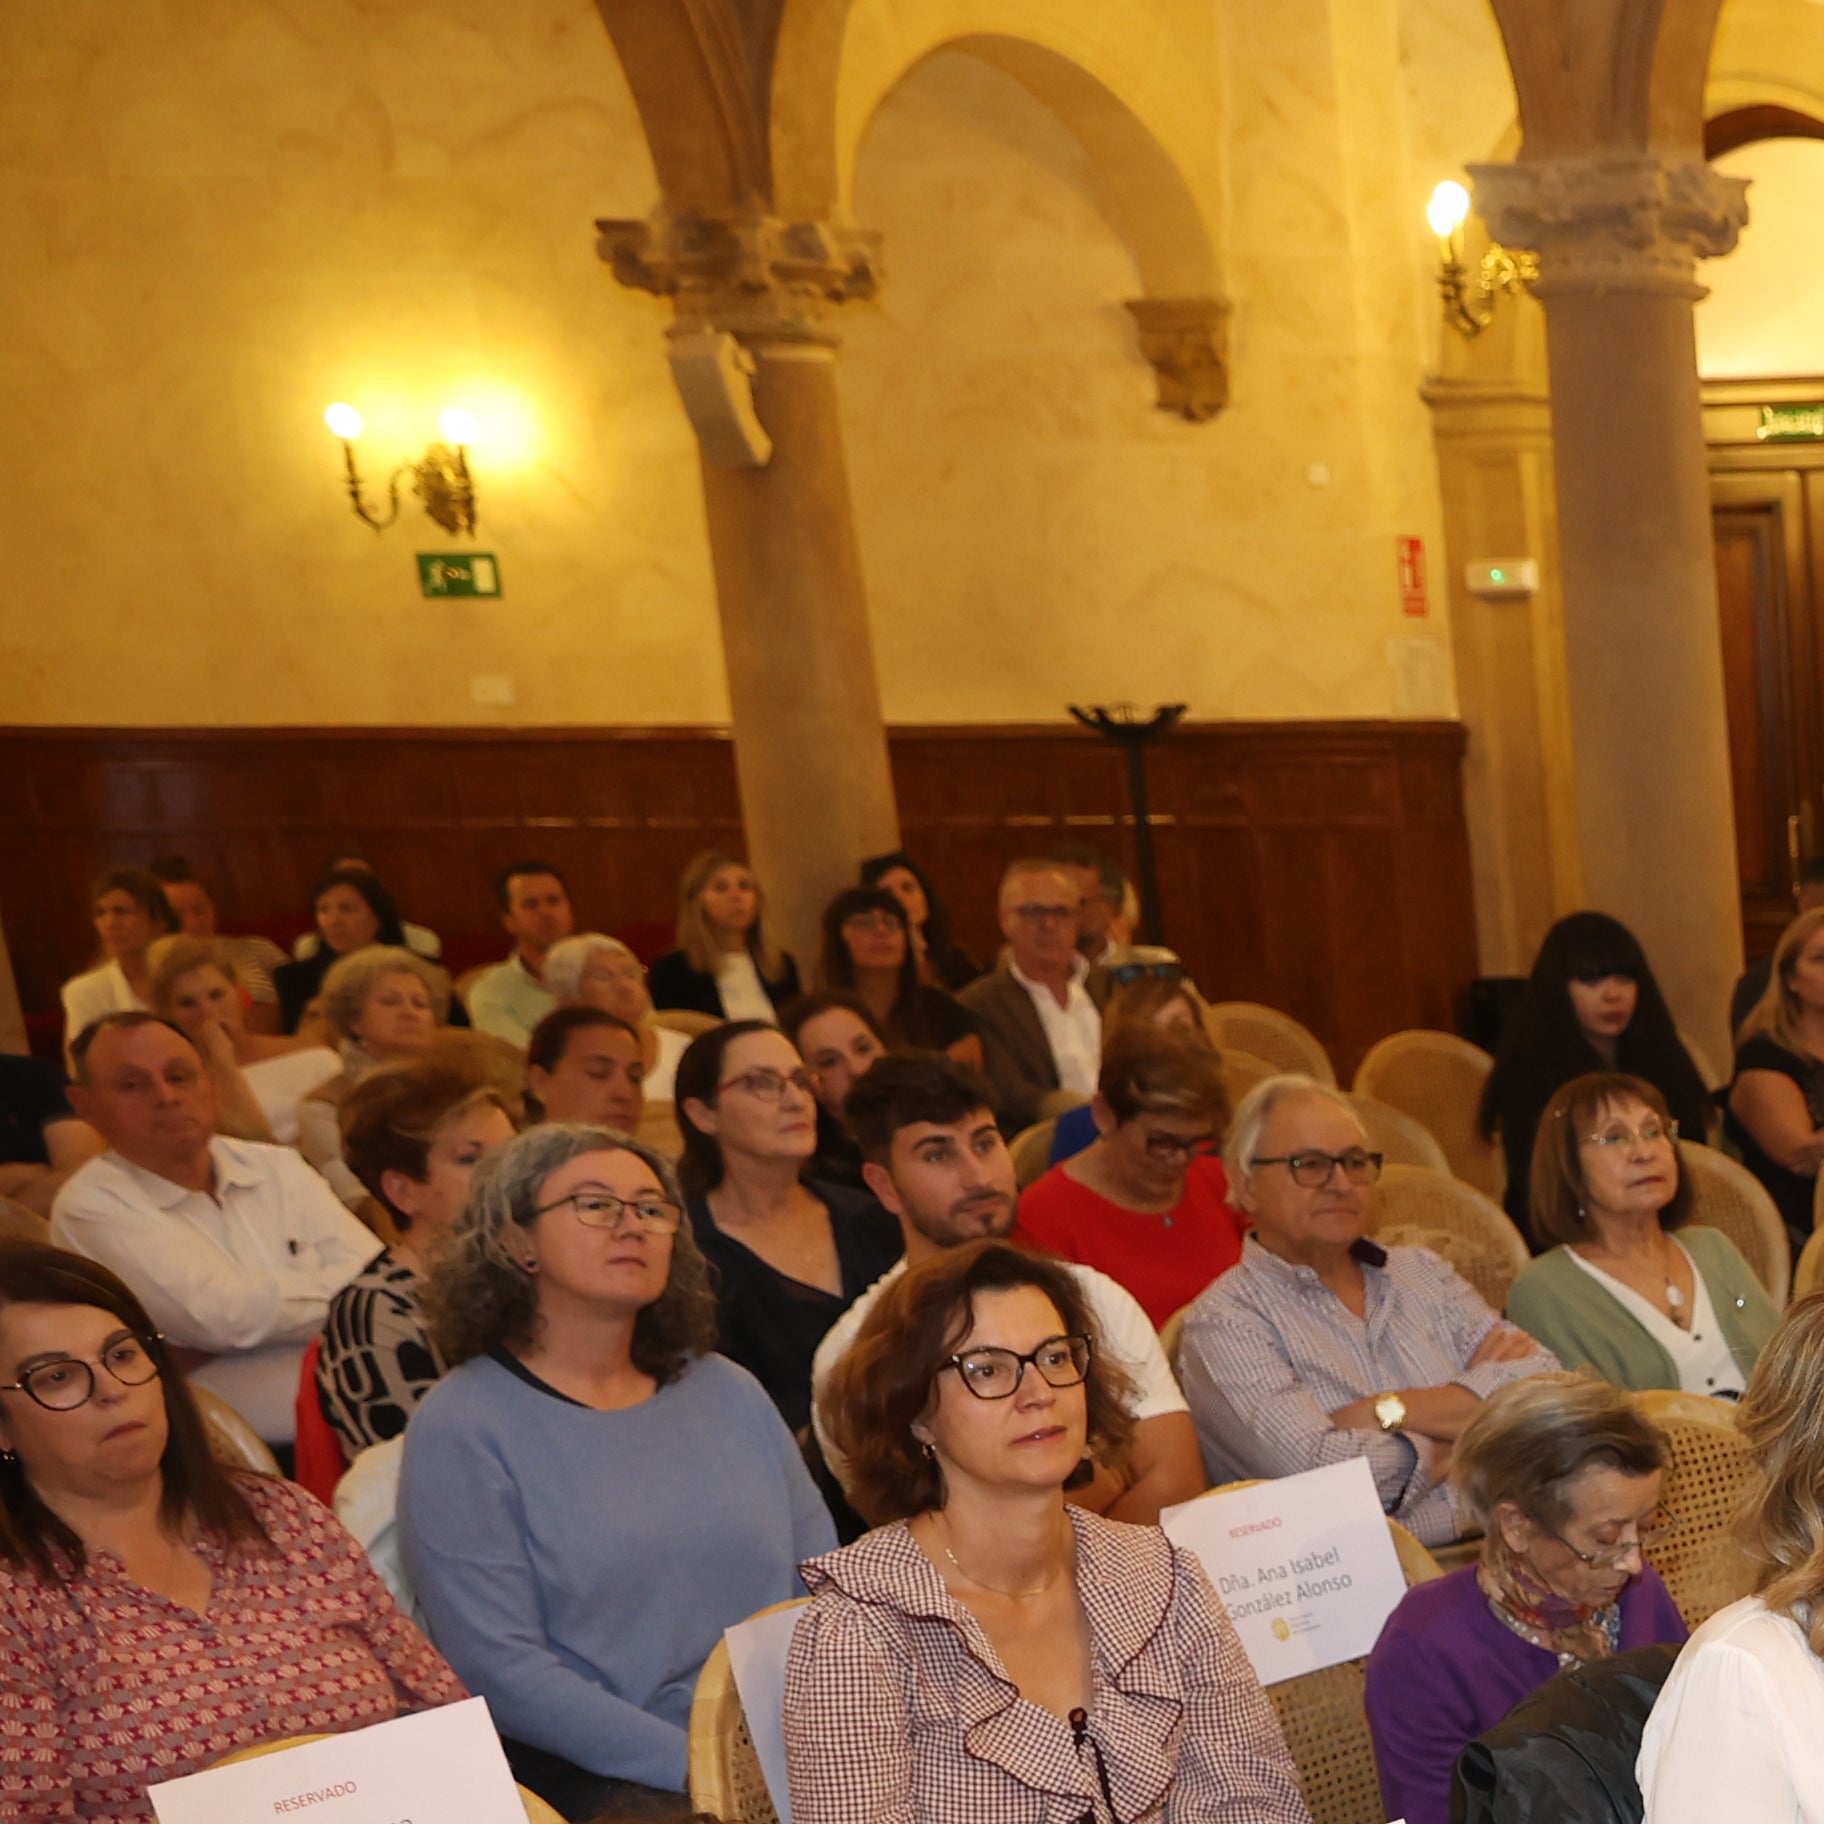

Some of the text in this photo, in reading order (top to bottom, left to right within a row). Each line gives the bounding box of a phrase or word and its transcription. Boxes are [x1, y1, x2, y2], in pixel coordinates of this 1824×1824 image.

[1219, 1546, 1341, 1595] Dña. Ana Isabel
[1296, 1573, 1353, 1601] Alonso
[273, 1780, 358, 1815] RESERVADO
